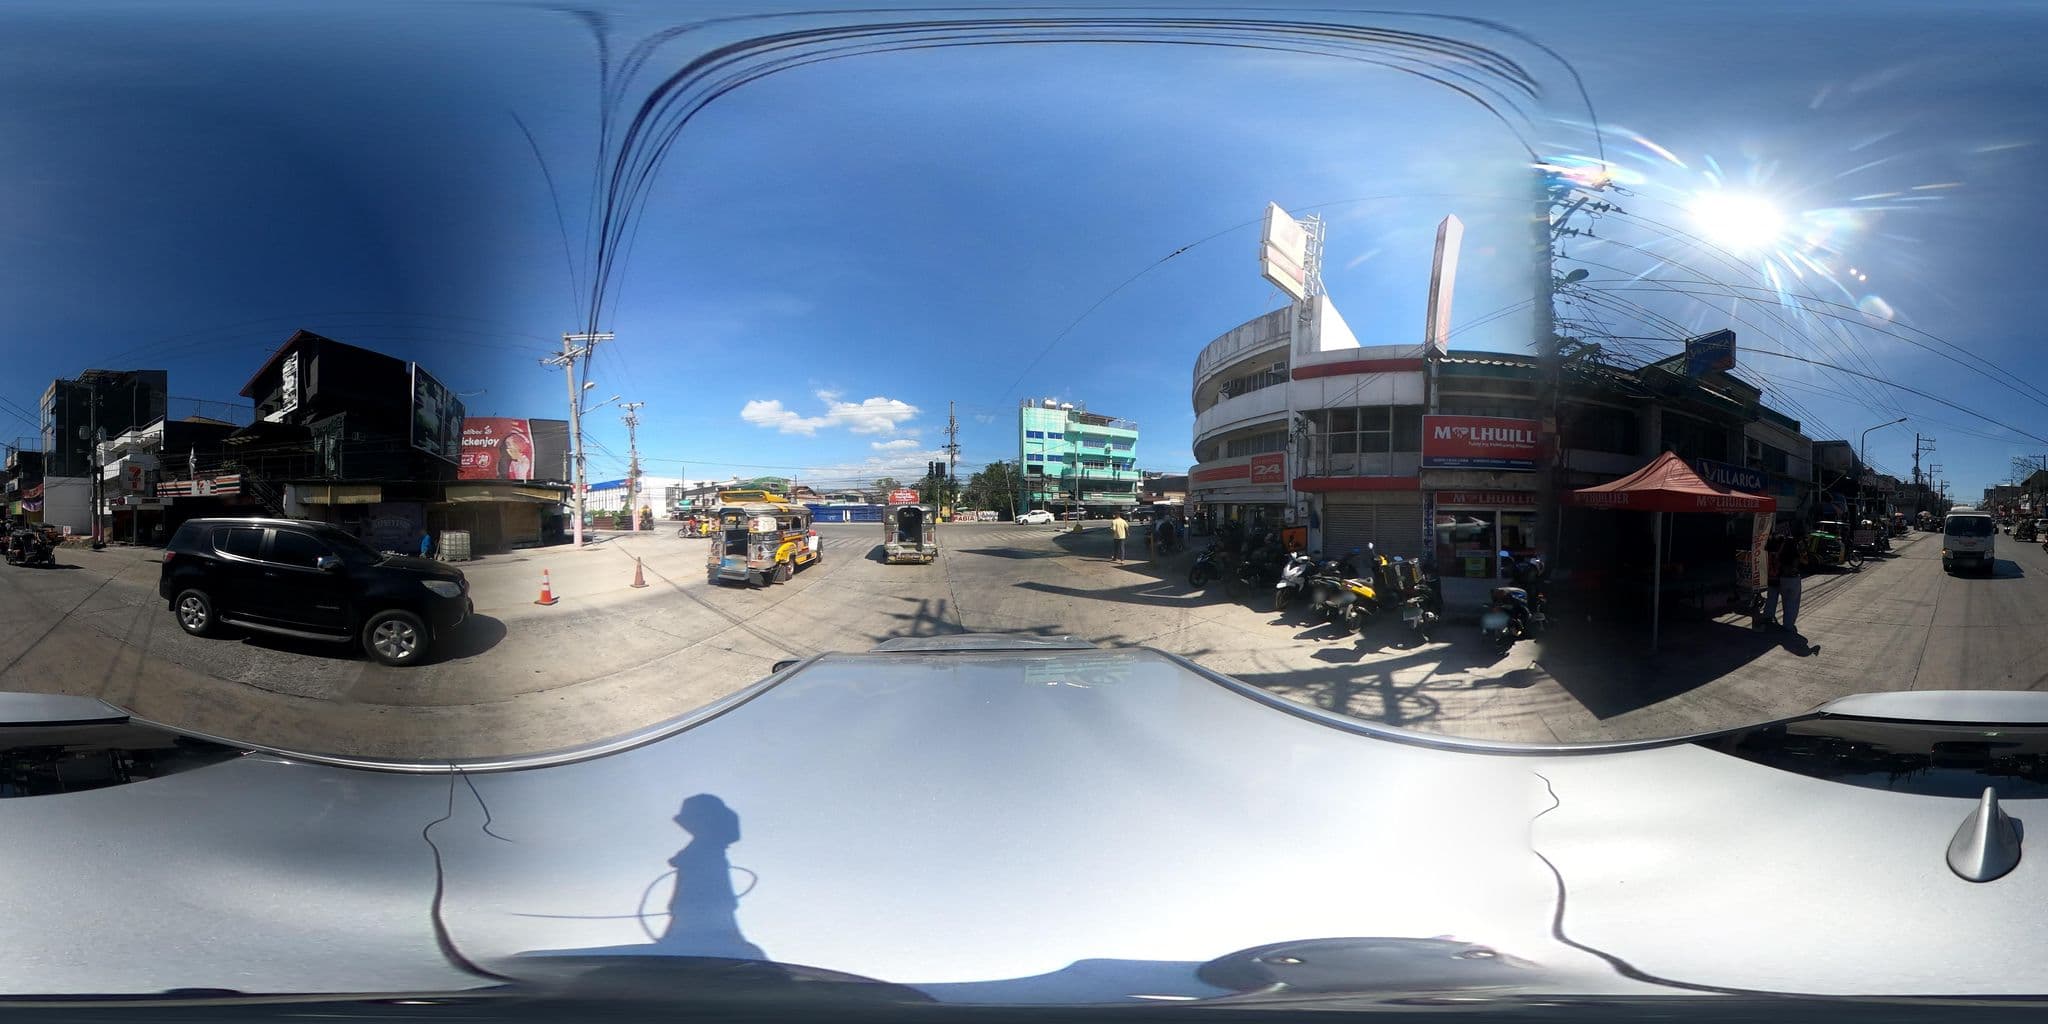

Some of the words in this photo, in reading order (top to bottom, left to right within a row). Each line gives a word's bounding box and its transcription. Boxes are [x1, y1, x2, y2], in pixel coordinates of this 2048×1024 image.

[1470, 427, 1536, 443] LHUILL
[461, 437, 499, 447] ickenjoy
[1254, 464, 1281, 475] 24
[1703, 462, 1761, 489] VILLARICA
